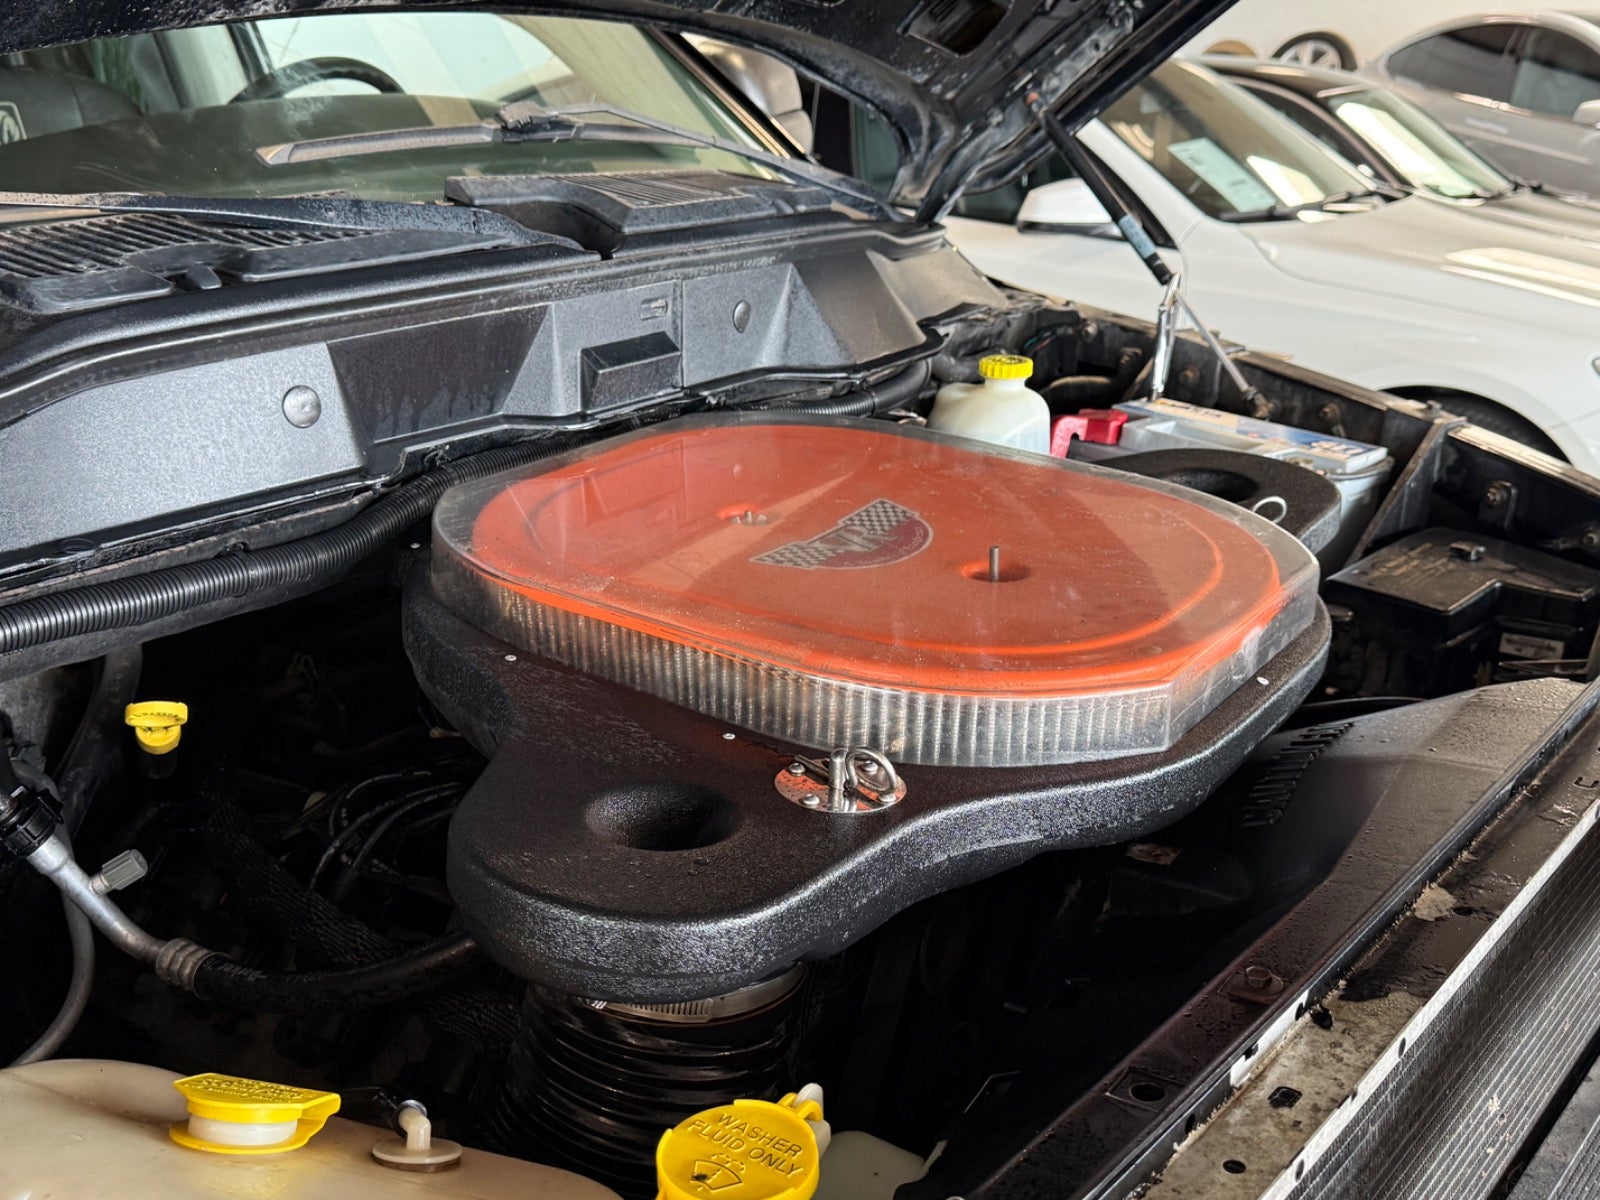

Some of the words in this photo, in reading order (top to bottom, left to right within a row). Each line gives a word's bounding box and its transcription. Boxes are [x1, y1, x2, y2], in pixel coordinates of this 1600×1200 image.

[687, 1119, 745, 1151] FLUID
[748, 1147, 803, 1178] ONLY
[718, 1112, 803, 1158] WASHER
